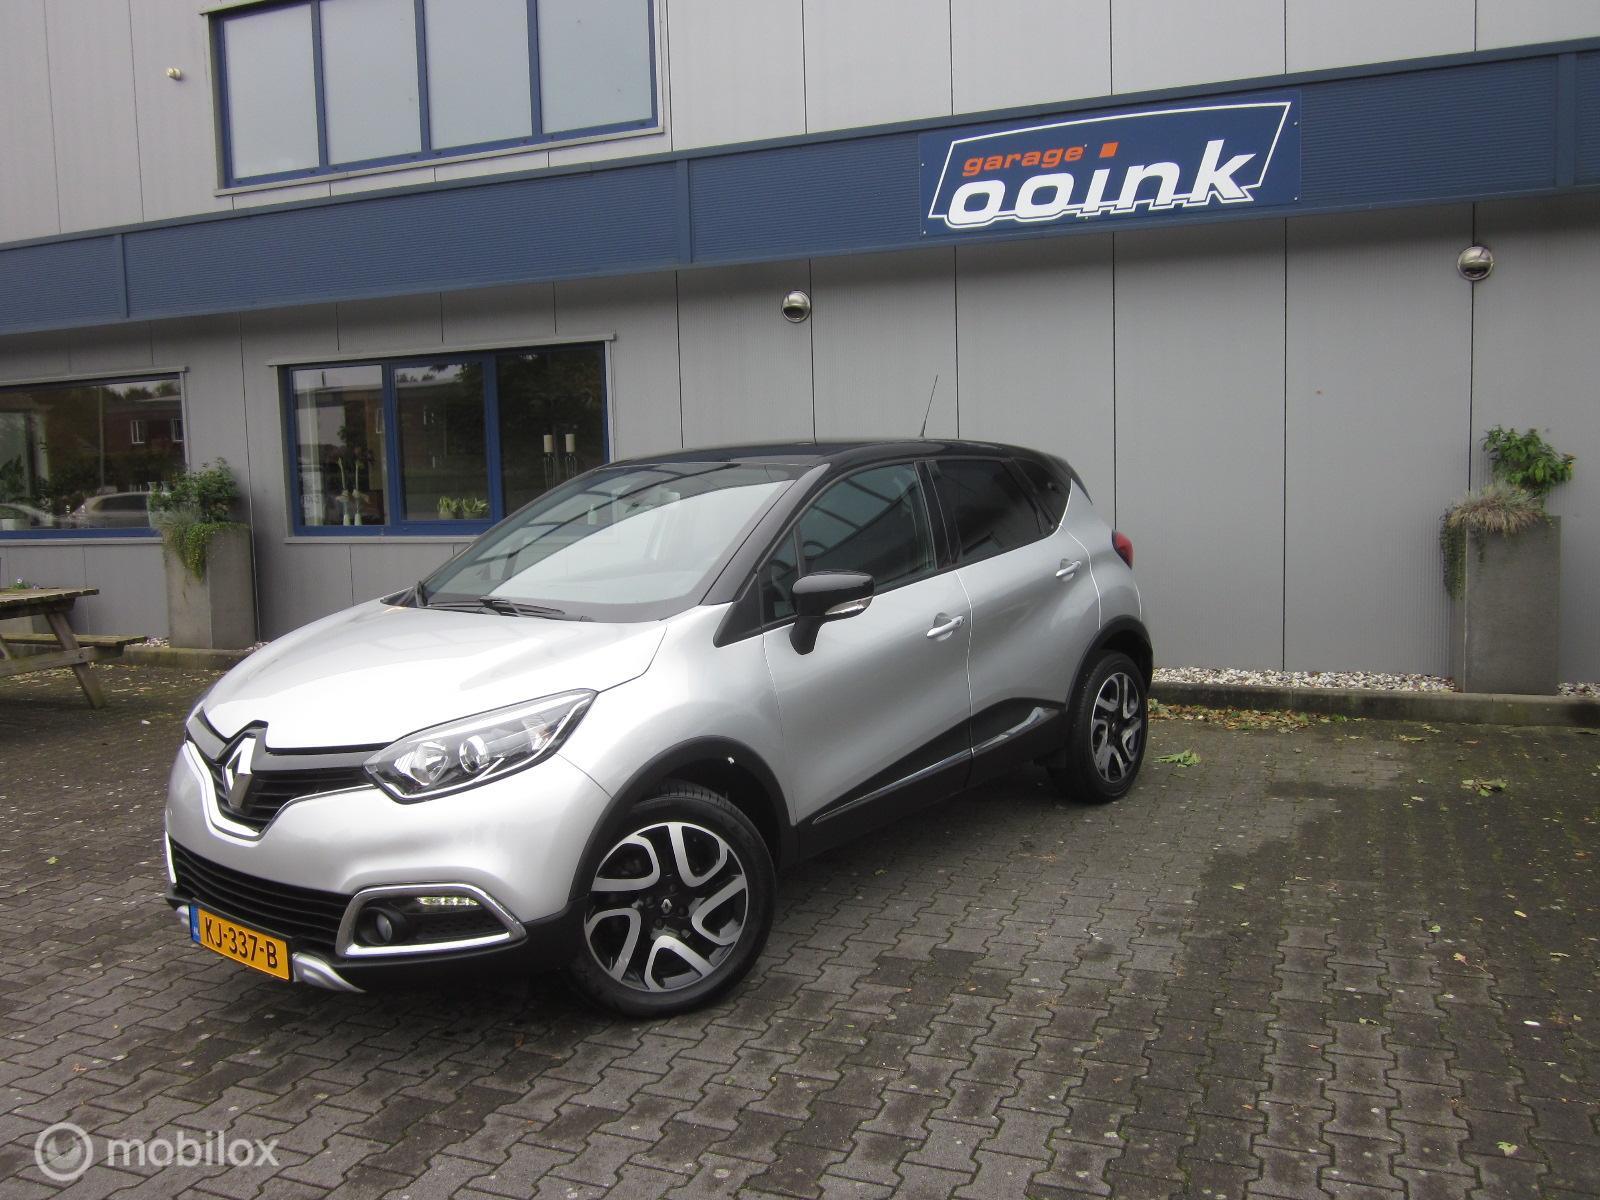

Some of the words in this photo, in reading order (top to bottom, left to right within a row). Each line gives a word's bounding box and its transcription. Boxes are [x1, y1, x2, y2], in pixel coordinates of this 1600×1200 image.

[948, 139, 1256, 224] ooink
[962, 145, 1084, 176] garage
[205, 917, 278, 968] KJ-337-B
